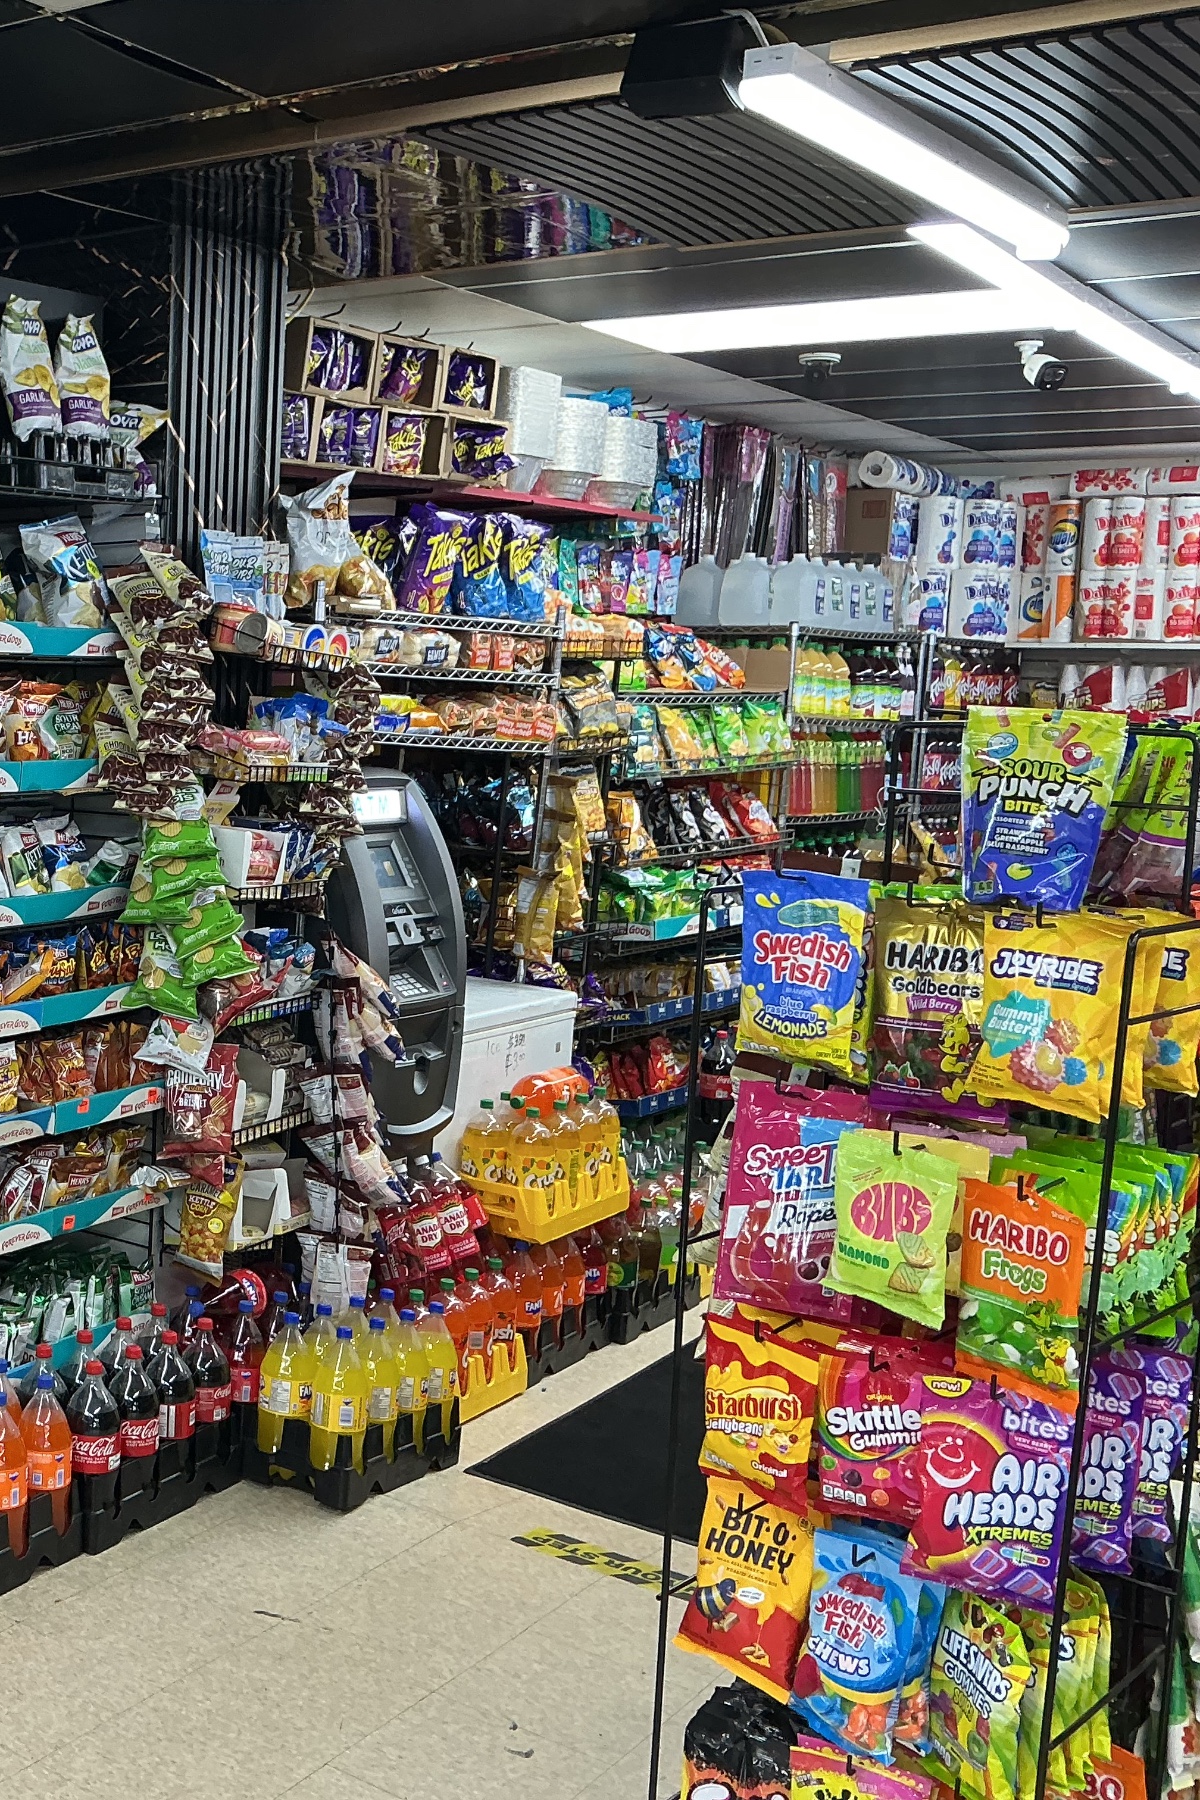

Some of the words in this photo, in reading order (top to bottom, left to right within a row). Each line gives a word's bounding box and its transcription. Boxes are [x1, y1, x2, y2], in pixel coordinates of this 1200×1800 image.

[18, 391, 47, 405] GARLIC
[68, 399, 95, 412] GARLIC
[423, 526, 462, 578] Takis
[1000, 759, 1066, 783] SOUR
[353, 793, 389, 816] ATM
[978, 775, 1091, 814] PUNCH
[1004, 799, 1048, 815] BITES
[1004, 842, 1050, 855] RASPBERRY
[1019, 837, 1045, 847] APPLE
[754, 931, 852, 972] Swedish
[770, 956, 830, 990] Fish
[992, 949, 1102, 985] JOYRIDE
[892, 976, 981, 999] Goldbears
[765, 1004, 819, 1023] raspberry
[779, 996, 804, 1010] blue
[909, 998, 927, 1011] Wild
[927, 999, 959, 1014] Berry
[992, 1003, 1041, 1024] Gummy
[755, 1010, 827, 1039] LEMONADE
[987, 1016, 1040, 1037] Busters
[524, 1163, 564, 1190] Crush
[188, 1194, 217, 1209] KETTLE
[190, 1202, 210, 1215] CORN
[850, 1181, 933, 1243] BUBS
[449, 1219, 467, 1232] DRY
[969, 1207, 1070, 1266] HARIBO
[420, 1233, 439, 1244] DRY
[837, 1240, 890, 1270] DIAMOND
[981, 1248, 1048, 1295] Frogs
[930, 1377, 964, 1393] new!
[705, 1389, 801, 1421] Starburst
[705, 1418, 764, 1438] Jellybeans
[826, 1405, 922, 1436] Skittle
[1002, 1410, 1070, 1441] bites
[849, 1429, 922, 1451] Gummi
[1013, 1434, 1031, 1444] VERY
[750, 1460, 788, 1479] Original
[992, 1453, 1063, 1499] AIR
[943, 1490, 1057, 1532] HEADS
[965, 1525, 1054, 1546] XTREMES
[704, 1527, 796, 1575] HONEY
[814, 1590, 888, 1640] Swedish
[822, 1610, 866, 1648] Fish
[806, 1635, 872, 1677] CHEWS
[943, 1661, 992, 1719] GUMMIES
